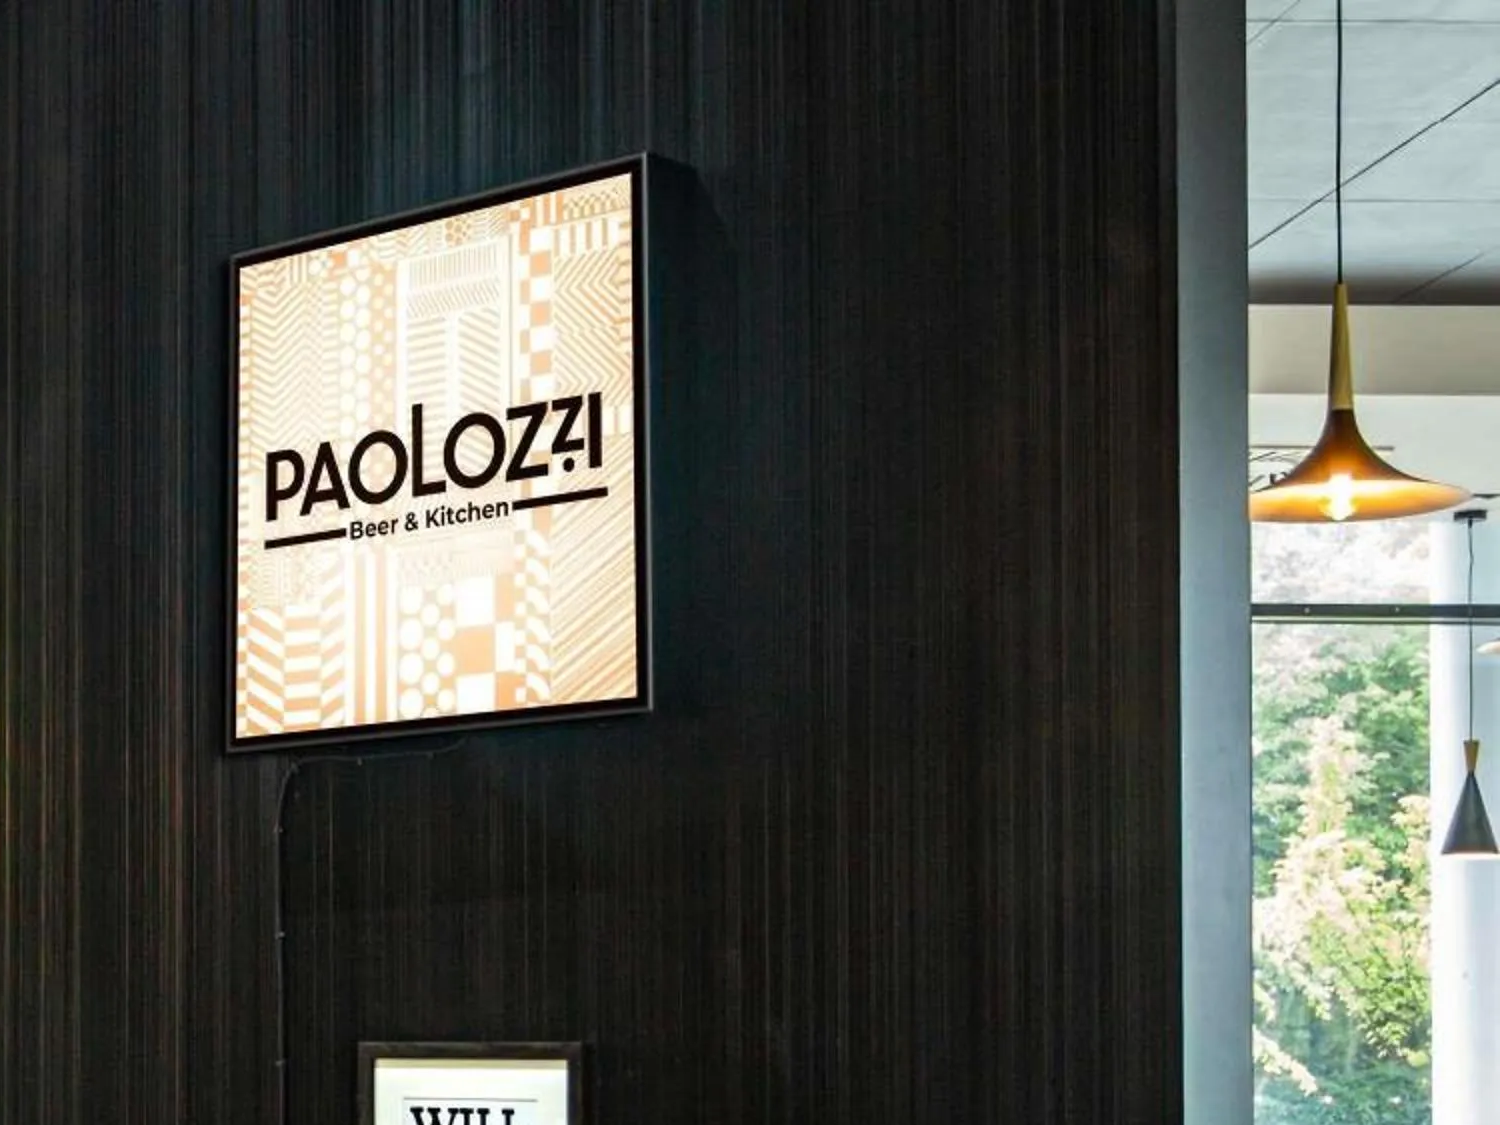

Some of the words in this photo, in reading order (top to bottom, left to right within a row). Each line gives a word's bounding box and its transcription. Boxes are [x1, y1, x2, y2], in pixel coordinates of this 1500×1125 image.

[266, 391, 602, 522] PAOLOZZI
[350, 516, 399, 540] Beer
[404, 512, 419, 531] &
[425, 501, 510, 528] Kitchen
